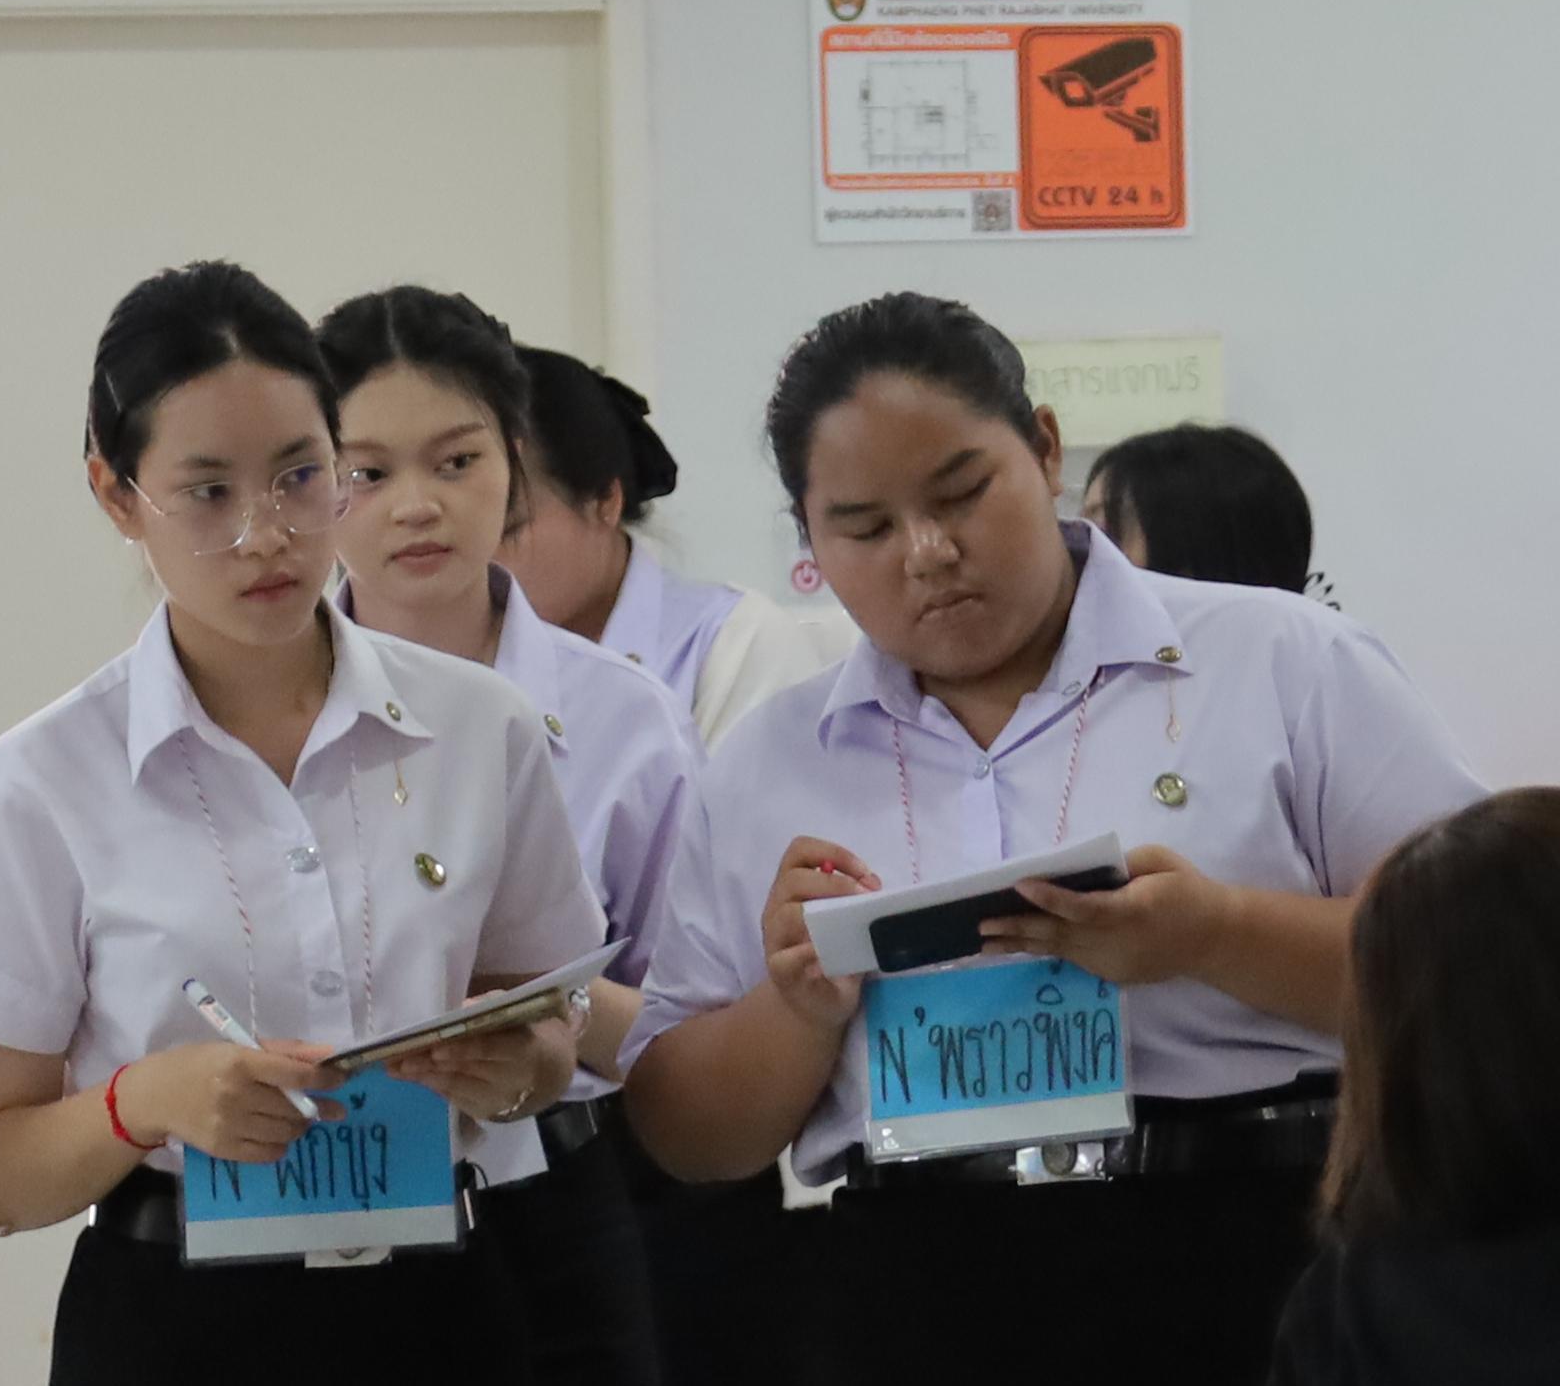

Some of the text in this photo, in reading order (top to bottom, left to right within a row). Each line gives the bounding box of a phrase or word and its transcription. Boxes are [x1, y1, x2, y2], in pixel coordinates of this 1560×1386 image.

[1038, 185, 1164, 206] CCTV 24 h
